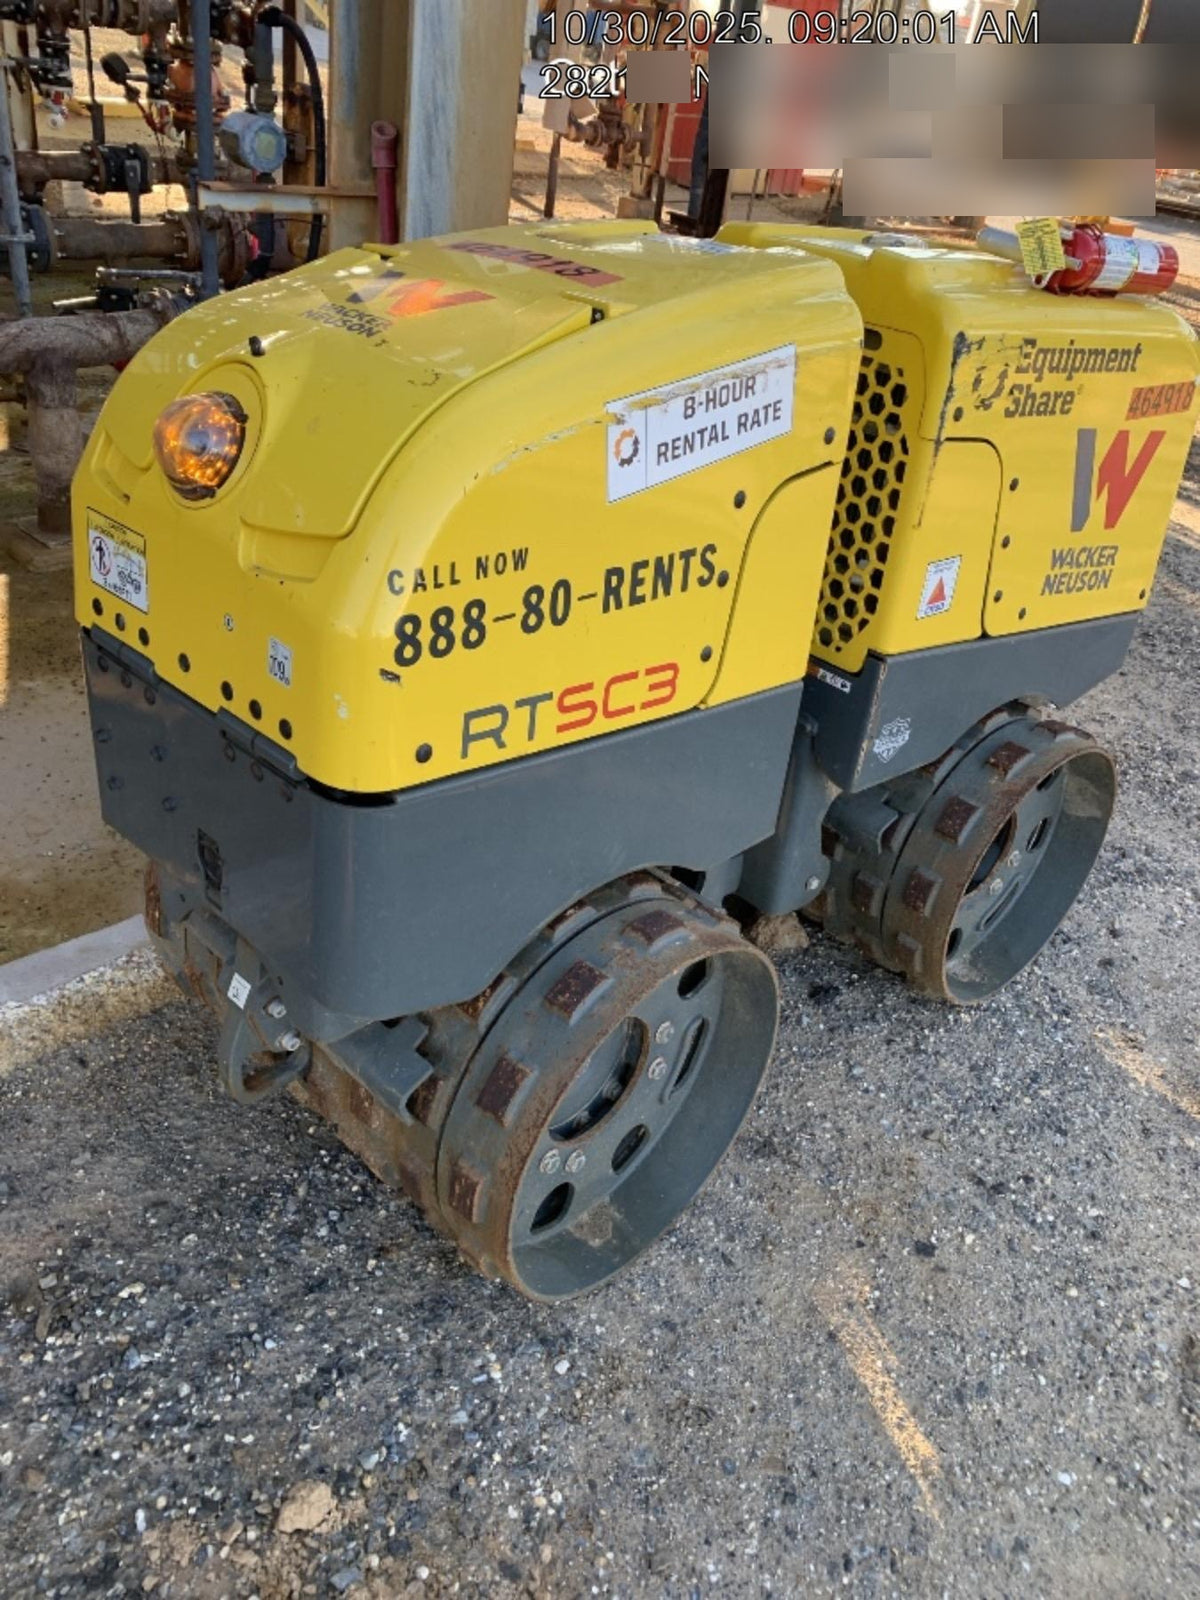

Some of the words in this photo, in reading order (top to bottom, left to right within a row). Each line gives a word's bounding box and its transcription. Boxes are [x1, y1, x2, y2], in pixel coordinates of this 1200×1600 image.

[1015, 338, 1142, 382] Equipment
[737, 399, 783, 436] RATE
[1004, 384, 1076, 418] Share
[656, 421, 730, 466] RENTAL
[387, 561, 461, 596] CALL
[475, 547, 530, 580] NOW
[1050, 545, 1119, 571] WACKER
[1040, 569, 1113, 596] NEUSON
[460, 662, 680, 760] RTSC3
